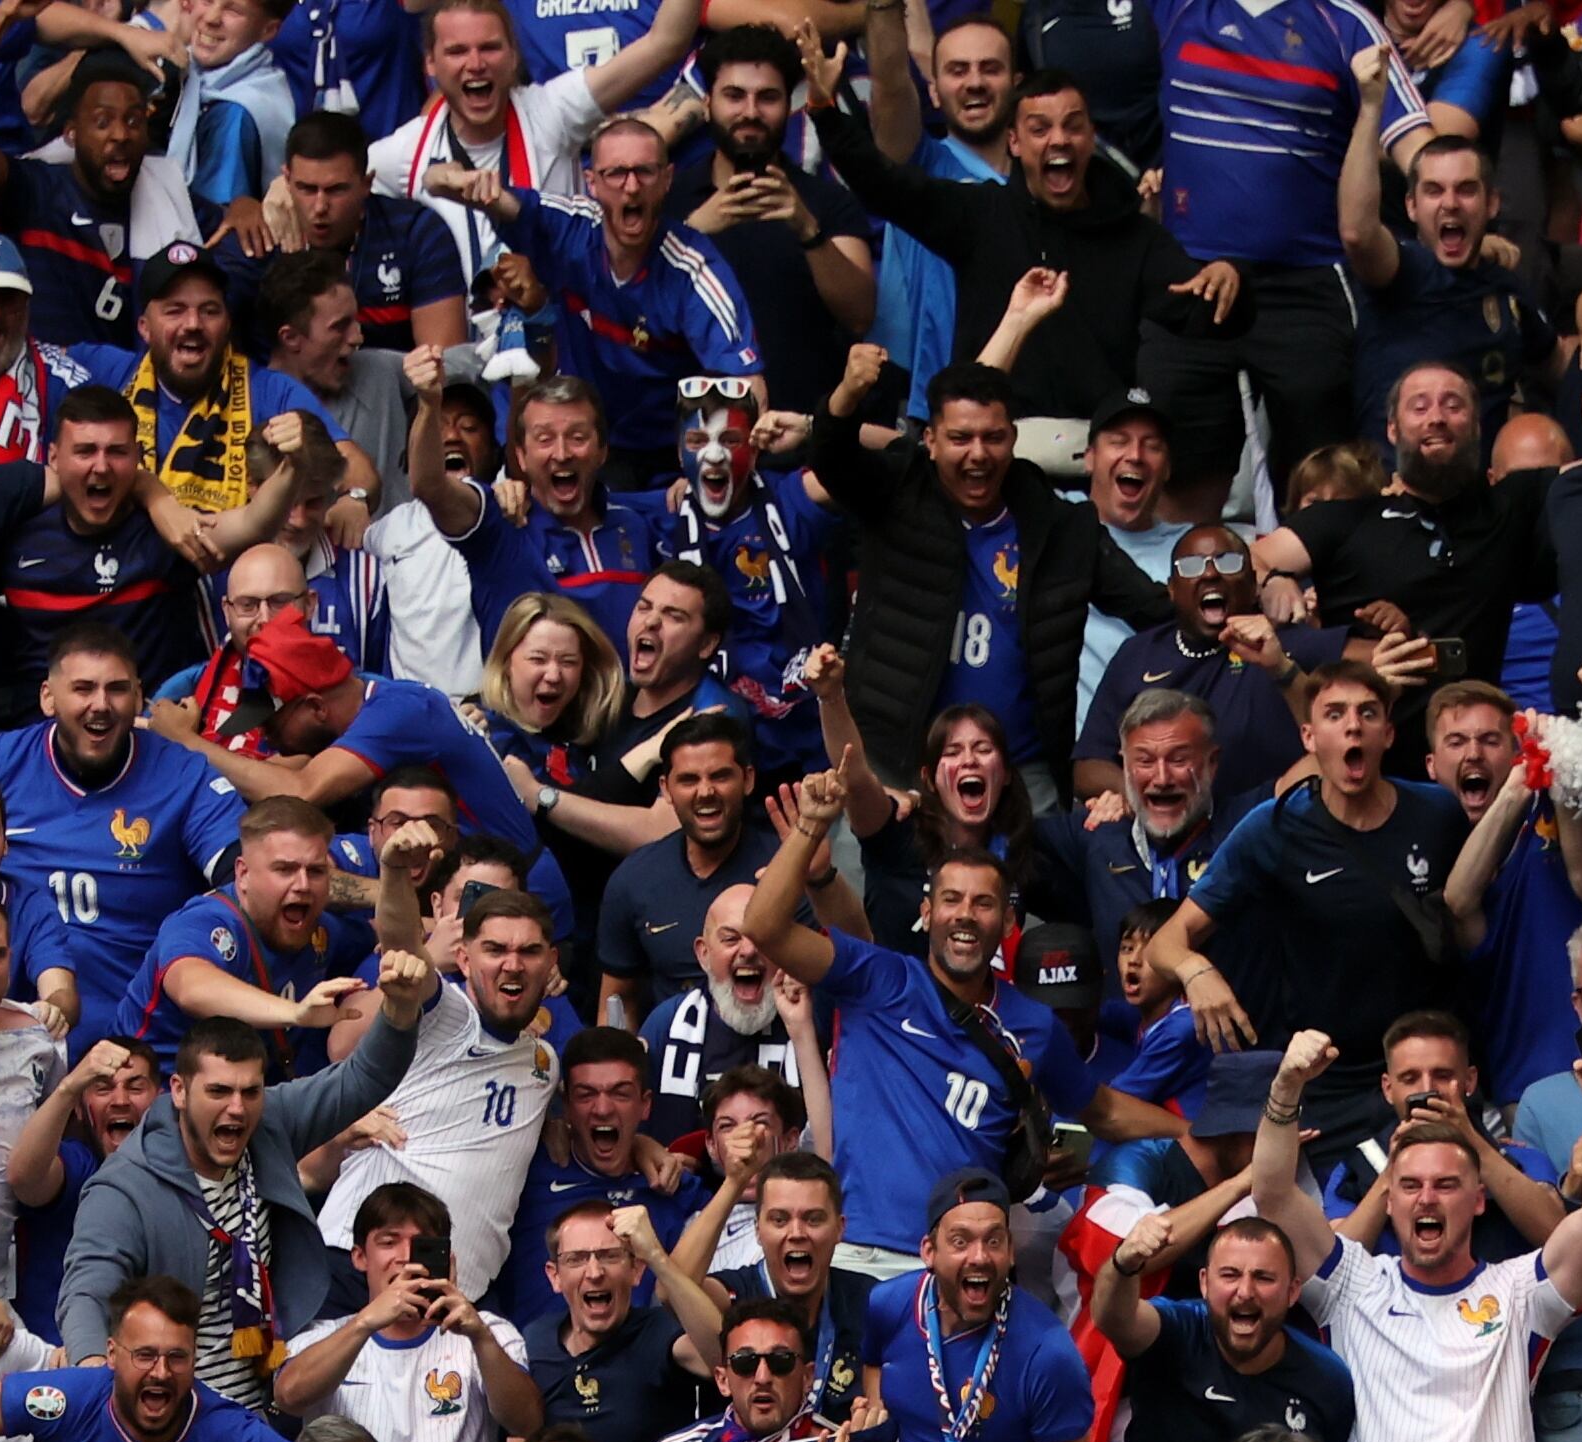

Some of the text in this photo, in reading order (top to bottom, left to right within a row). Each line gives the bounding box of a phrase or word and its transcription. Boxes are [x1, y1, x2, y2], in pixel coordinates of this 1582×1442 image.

[95, 276, 124, 322] 6
[948, 609, 993, 669] 18
[48, 870, 100, 924] 10
[1037, 966, 1079, 985] AJAX
[484, 1081, 516, 1129] 10
[943, 1070, 989, 1131] 10
